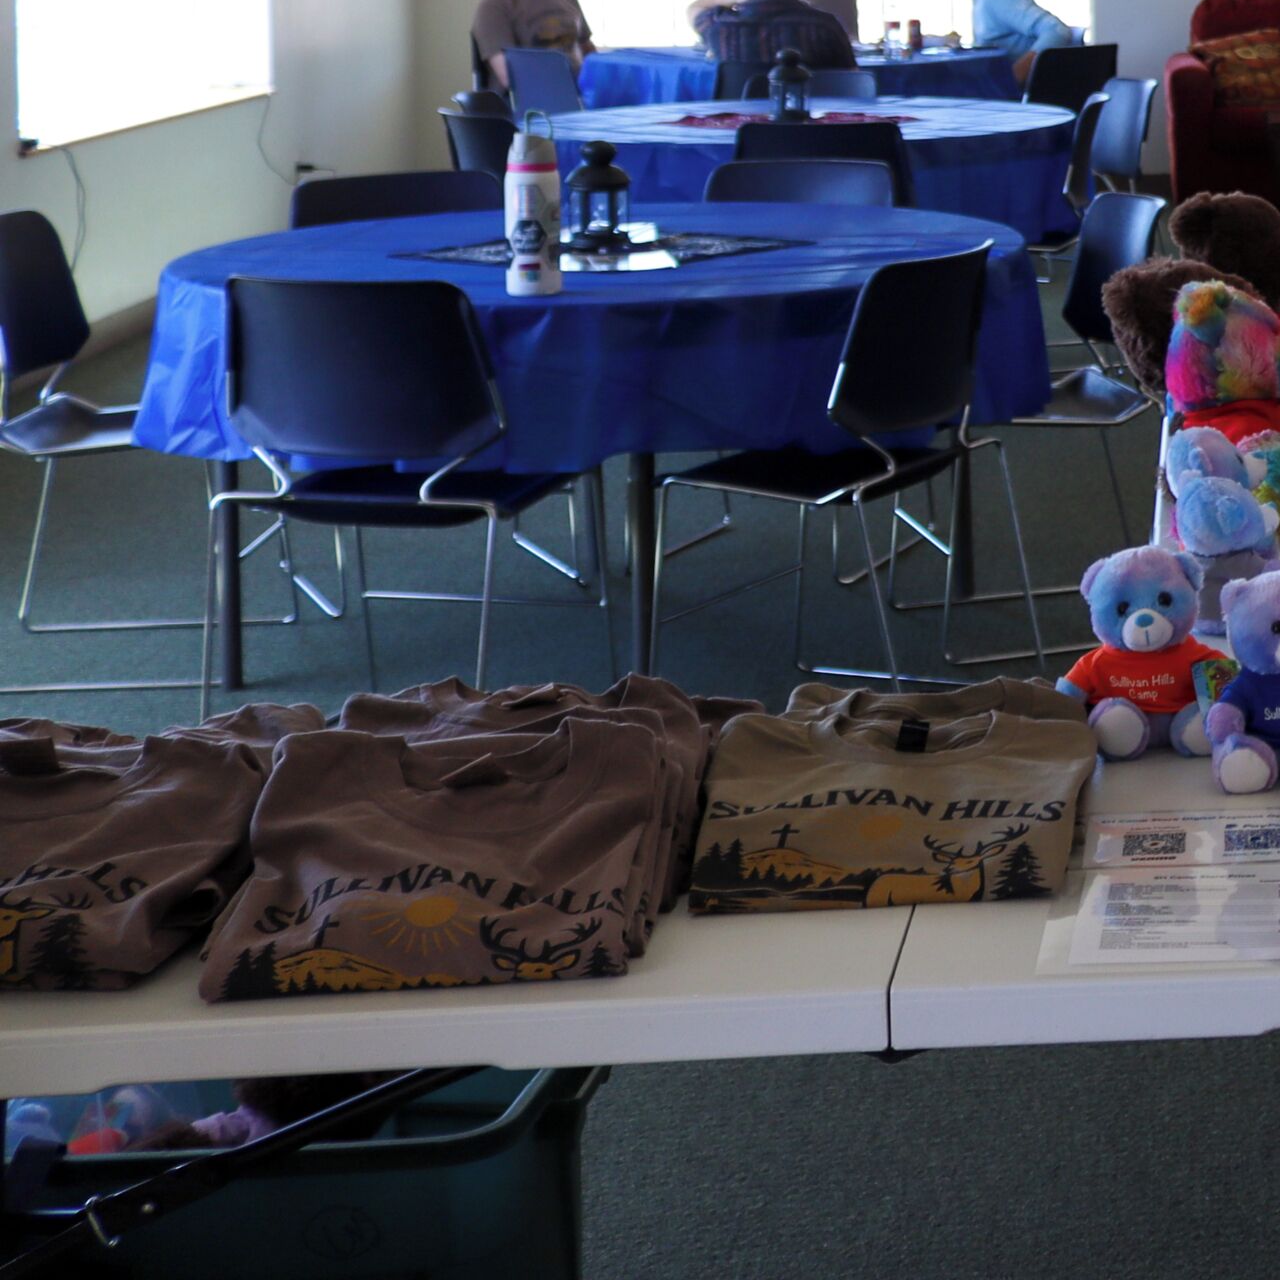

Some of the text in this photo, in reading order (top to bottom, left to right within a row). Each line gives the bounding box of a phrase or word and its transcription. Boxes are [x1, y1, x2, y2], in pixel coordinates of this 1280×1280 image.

[1109, 673, 1175, 689] Sullivan Hills
[1128, 688, 1158, 701] Camp
[939, 799, 1067, 822] HILLS
[15, 862, 149, 904] HLS
[254, 863, 498, 934] SULLIVAN
